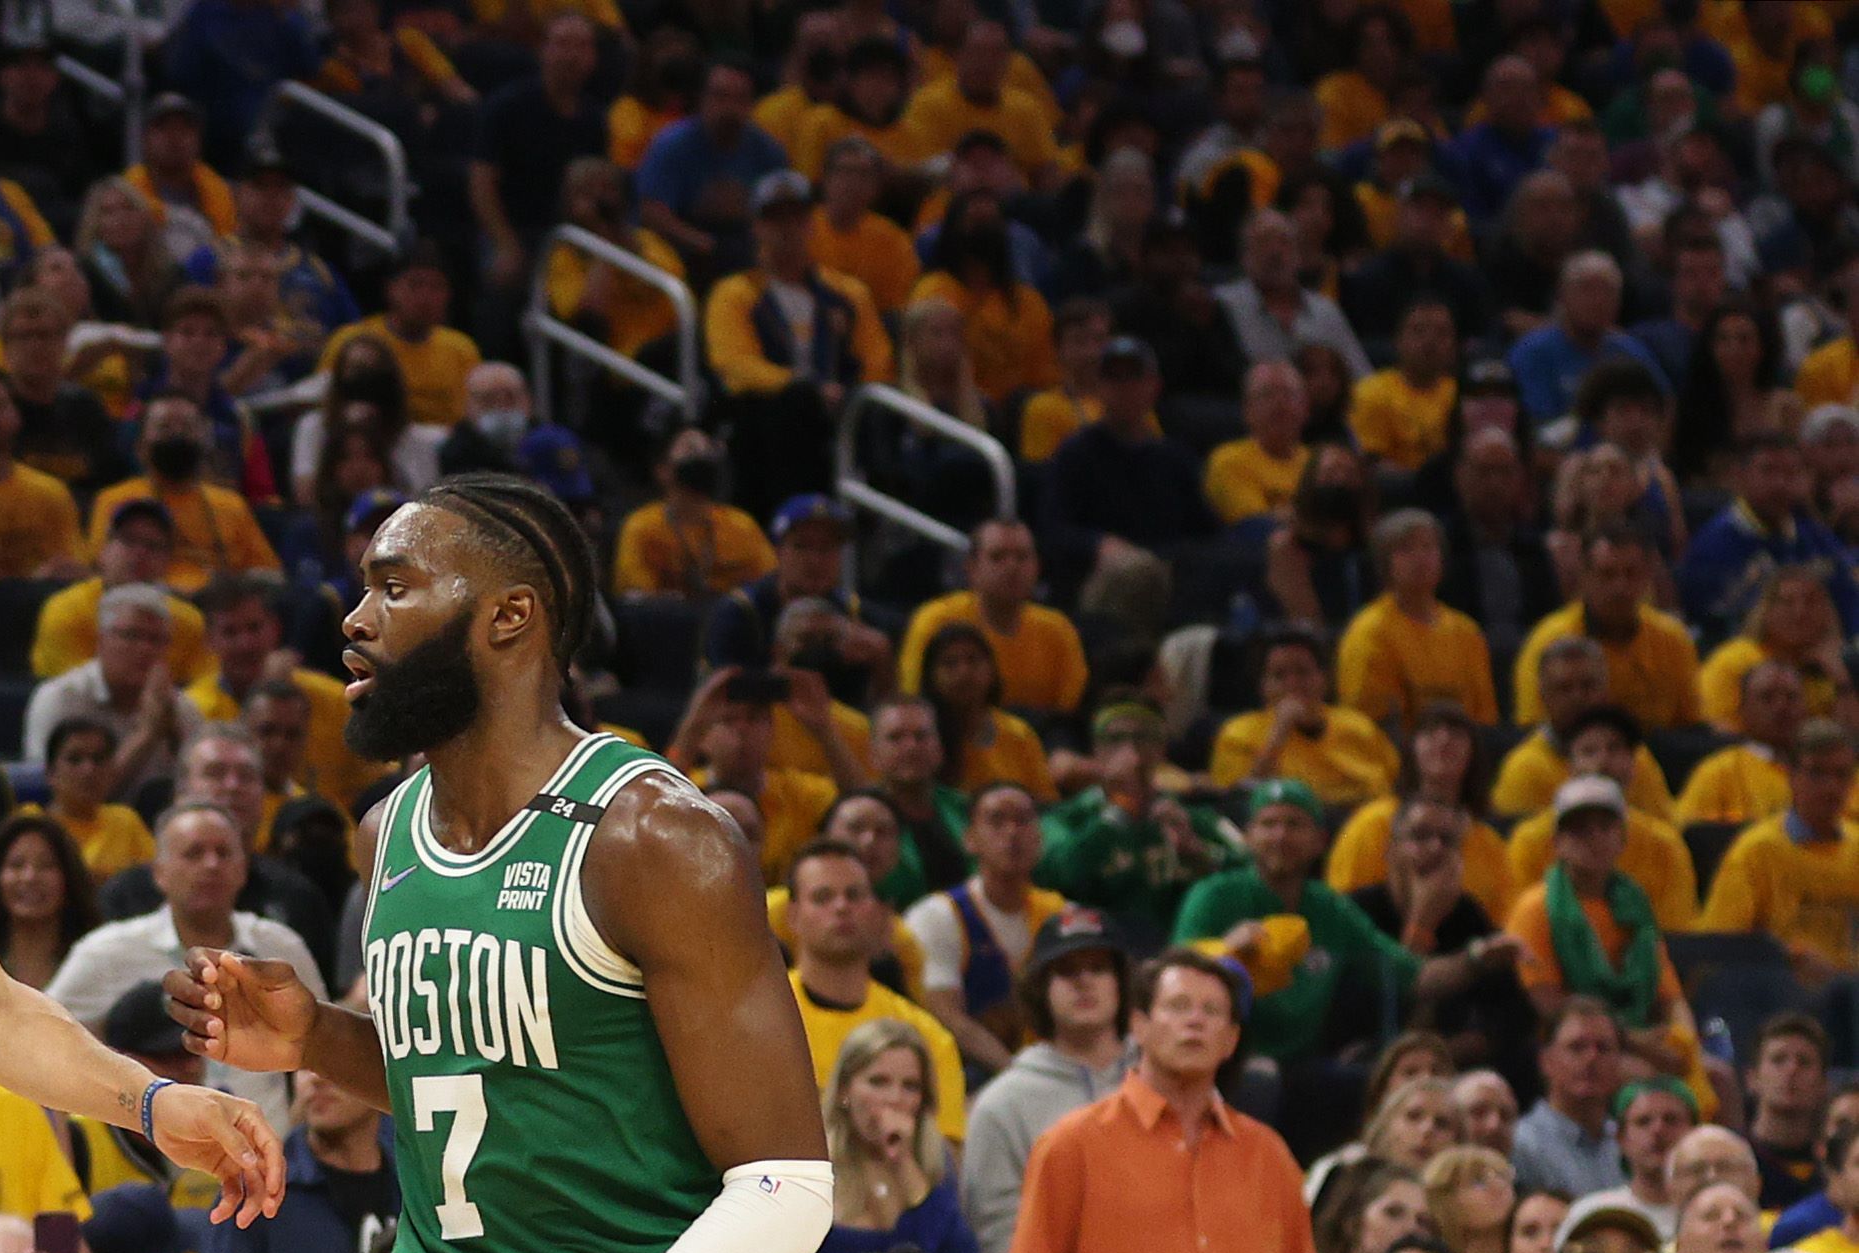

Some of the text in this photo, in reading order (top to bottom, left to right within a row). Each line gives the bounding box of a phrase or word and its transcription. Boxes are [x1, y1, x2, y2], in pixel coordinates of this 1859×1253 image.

[550, 797, 577, 818] 24
[503, 861, 552, 892] VISTA
[496, 890, 547, 910] PRINT
[367, 928, 559, 1070] BOSTON
[411, 1073, 489, 1240] 7
